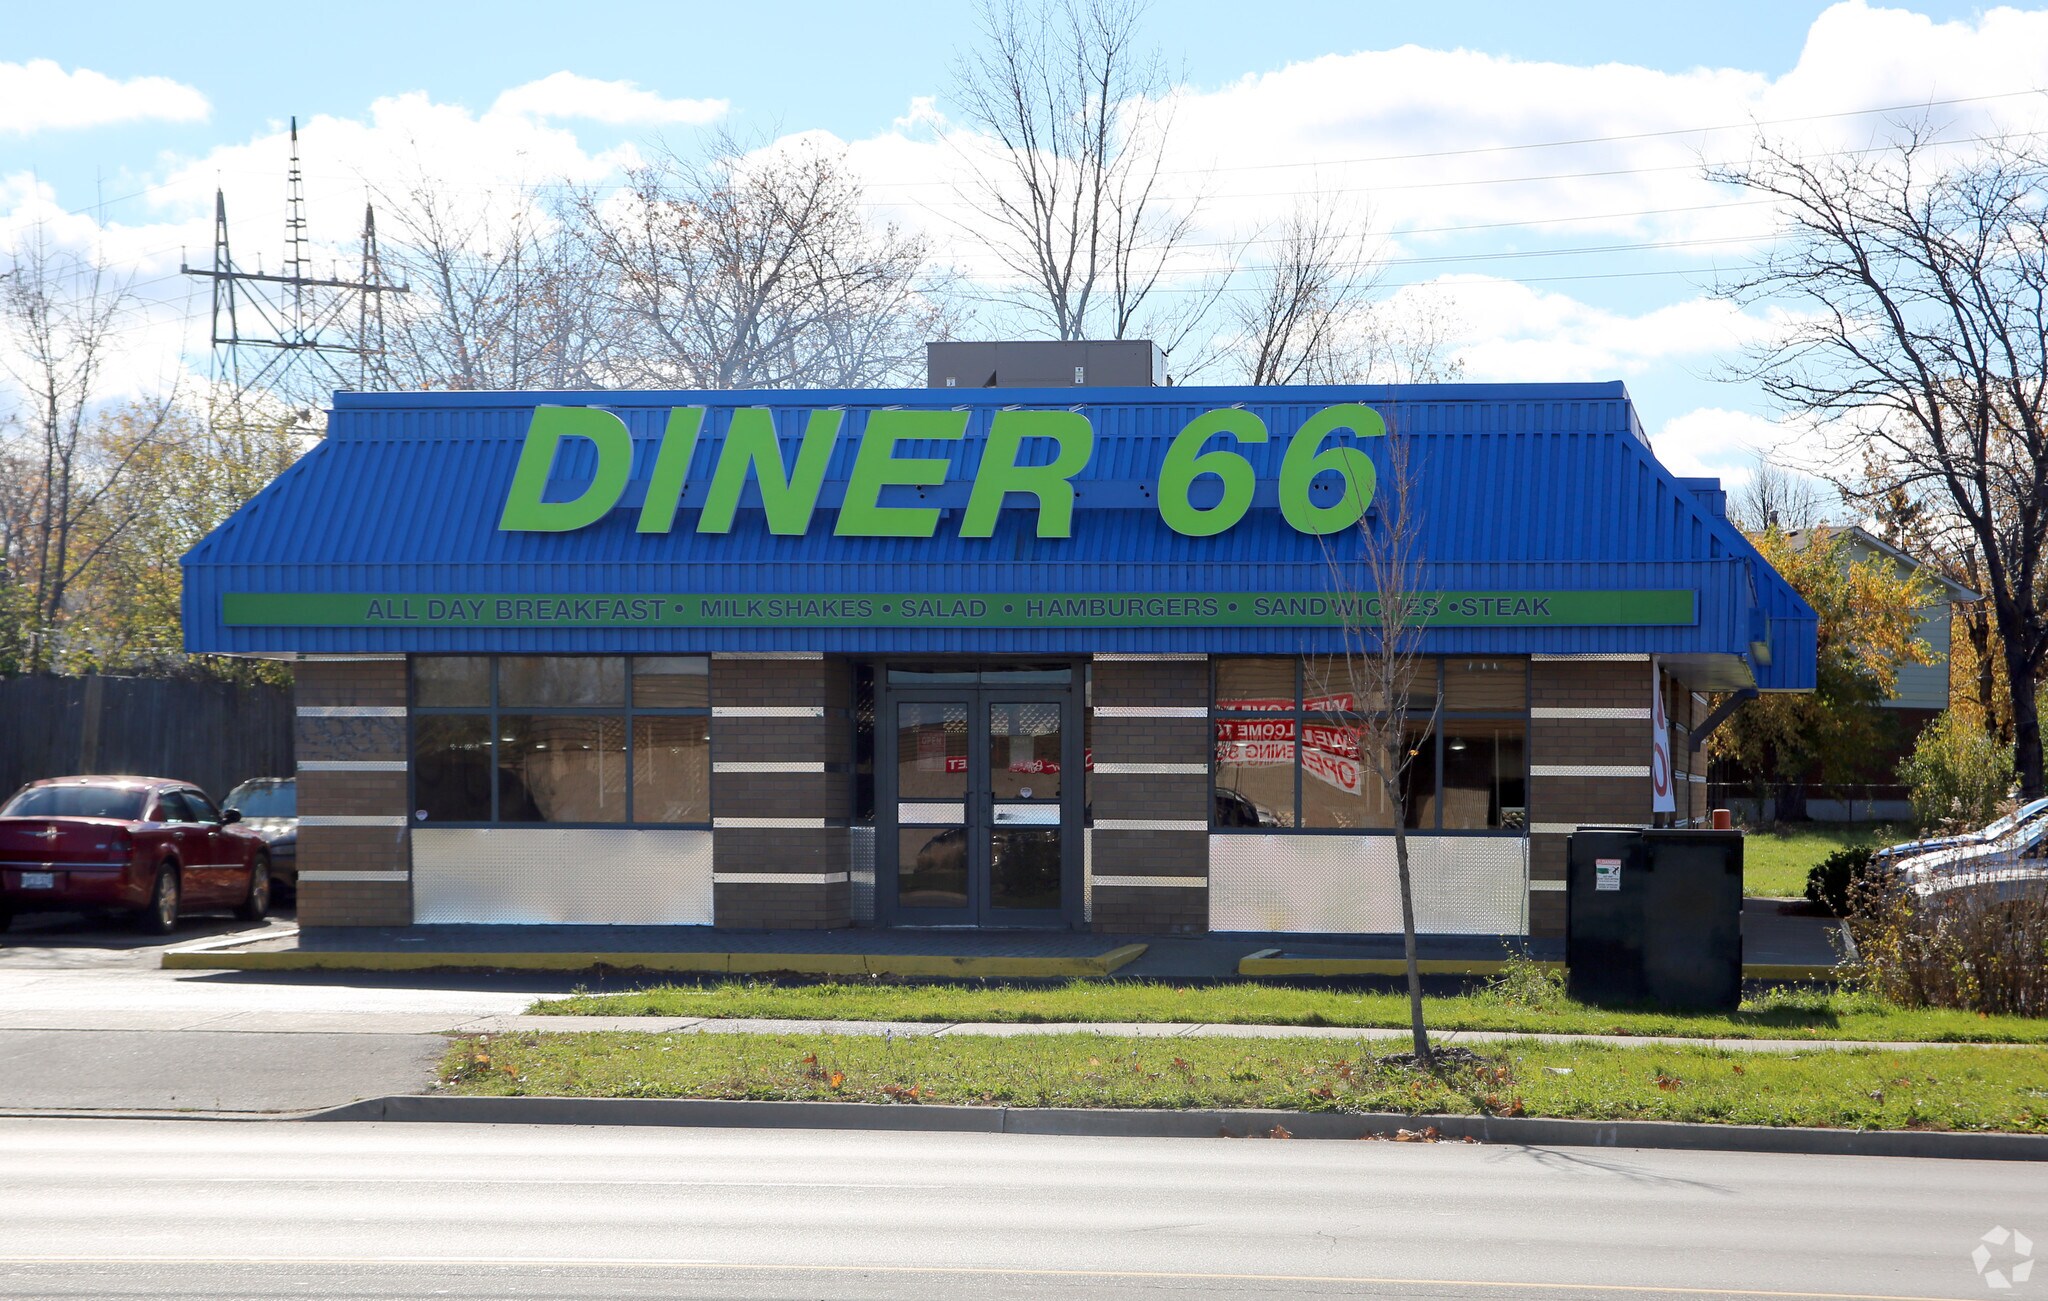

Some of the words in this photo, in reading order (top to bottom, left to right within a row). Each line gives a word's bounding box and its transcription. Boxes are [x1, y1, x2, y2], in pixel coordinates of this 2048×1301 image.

[498, 404, 1094, 539] DINER
[1157, 402, 1387, 536] 66
[365, 599, 418, 620] ALL
[427, 599, 486, 620] DAY
[495, 599, 666, 620] BREAKFAST
[900, 599, 987, 618] SALAD
[1026, 598, 1218, 618] HAMBURGERS
[1460, 597, 1552, 617] STEAK
